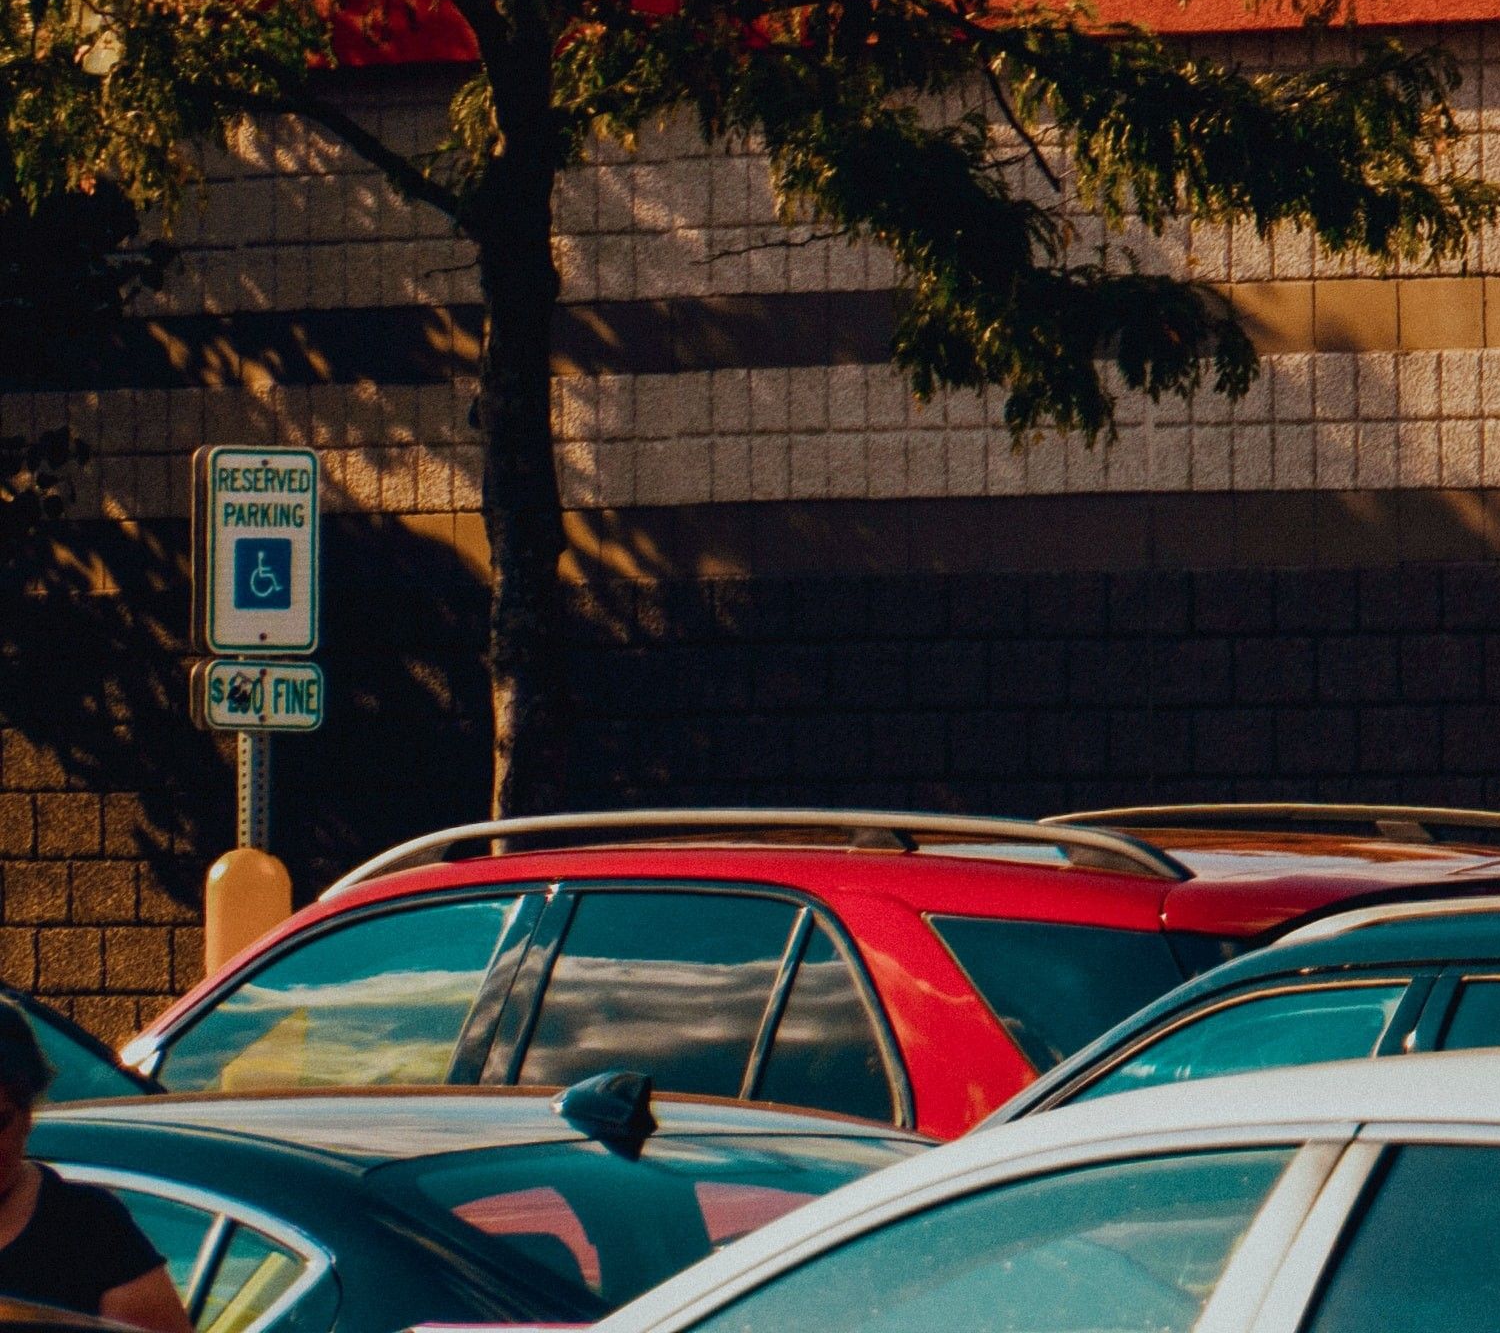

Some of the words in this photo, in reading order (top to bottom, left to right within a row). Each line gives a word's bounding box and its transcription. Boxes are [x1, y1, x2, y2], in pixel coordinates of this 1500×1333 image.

[217, 467, 311, 493] RESERVED
[223, 502, 305, 528] PARKING
[273, 677, 320, 715] FINE
